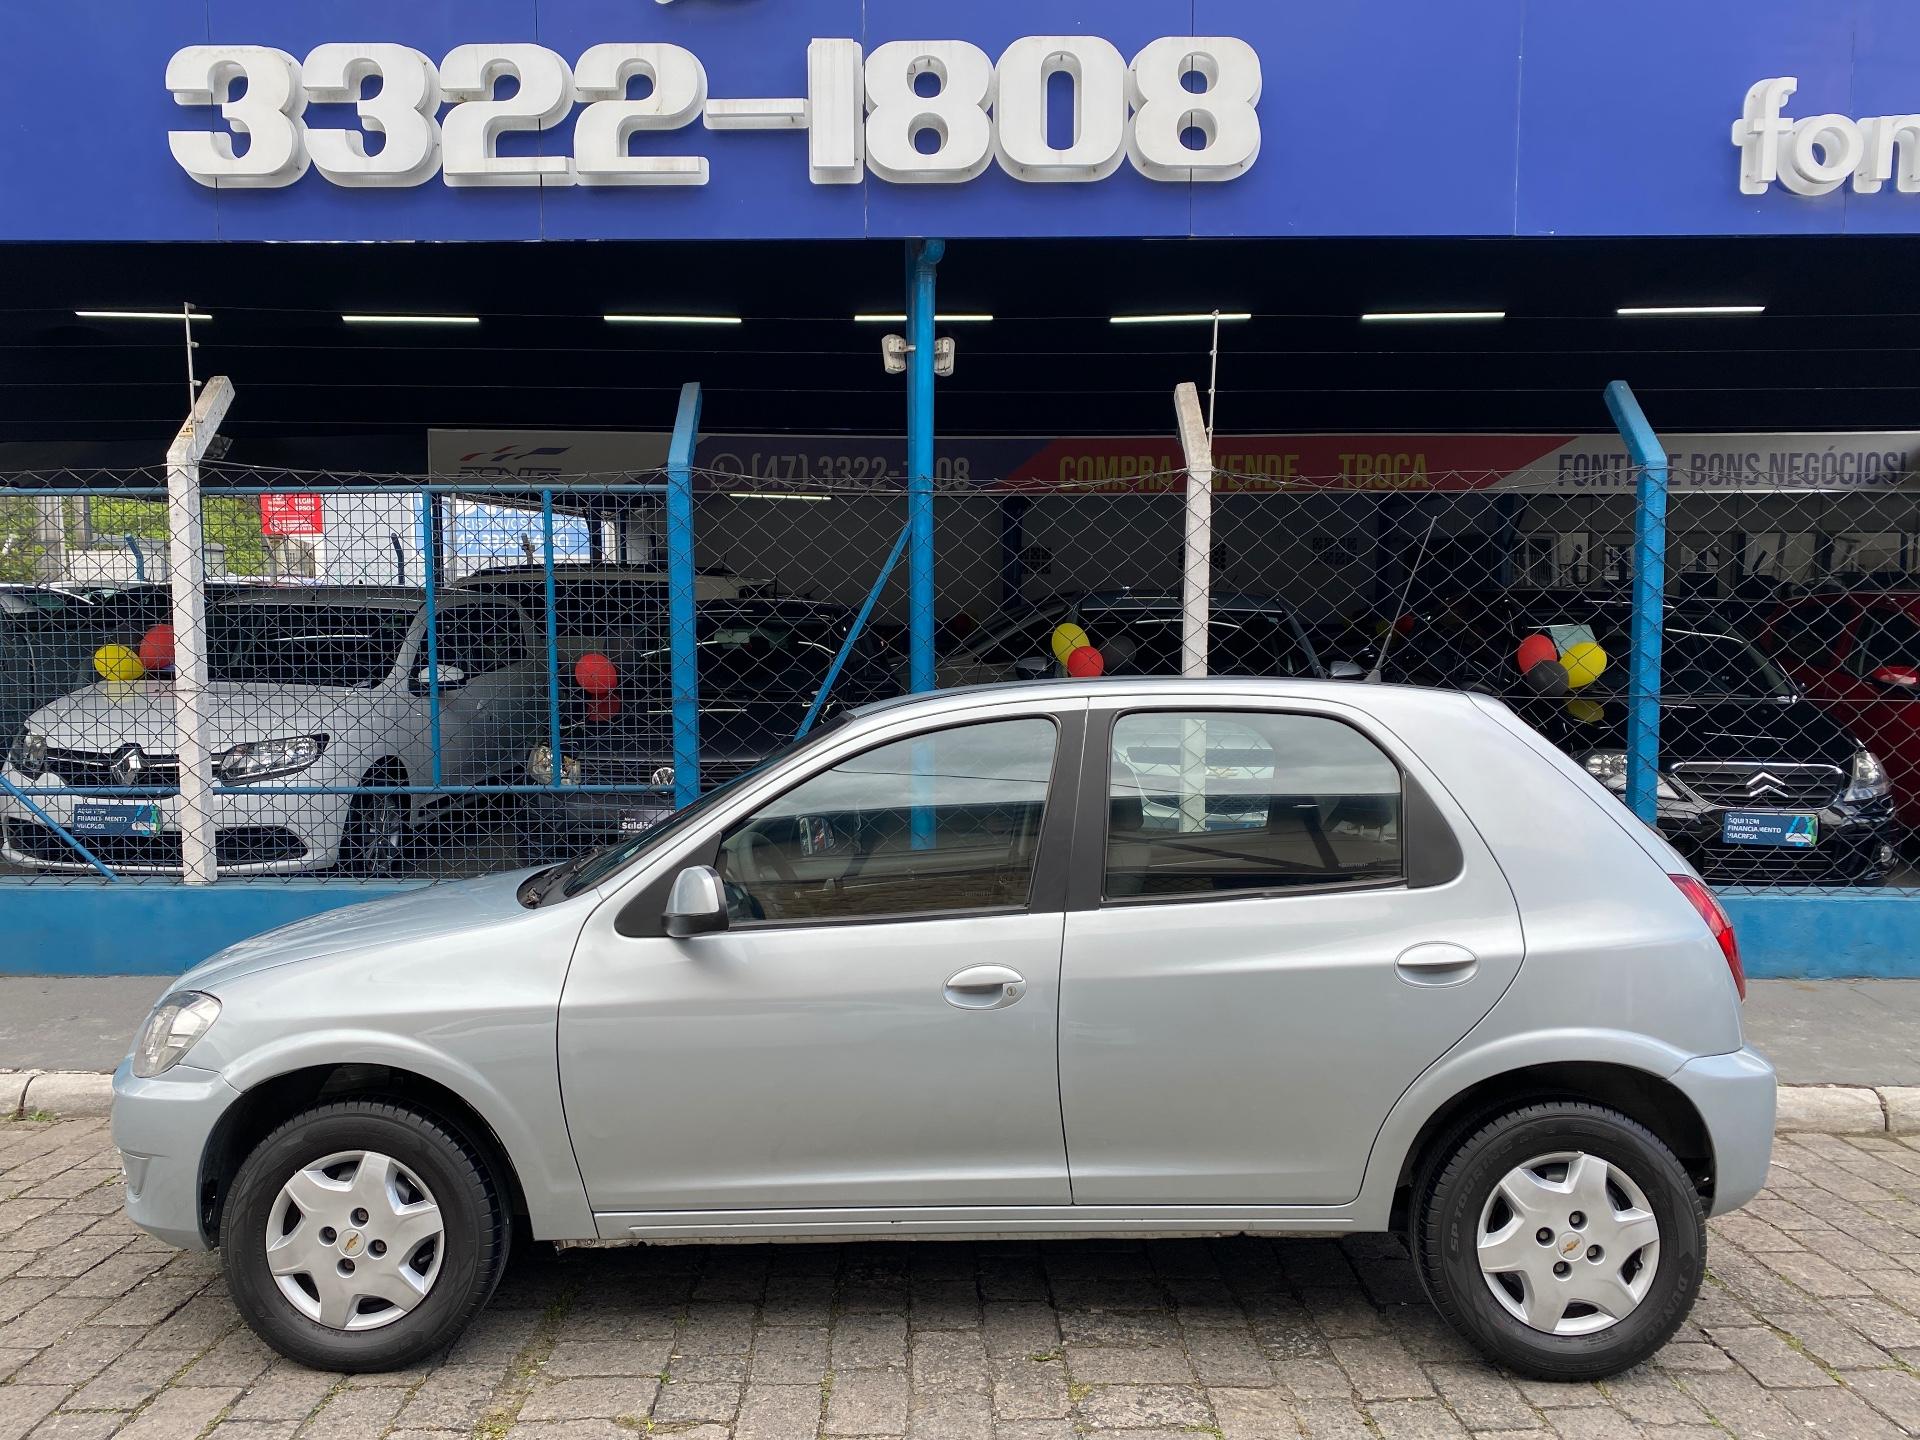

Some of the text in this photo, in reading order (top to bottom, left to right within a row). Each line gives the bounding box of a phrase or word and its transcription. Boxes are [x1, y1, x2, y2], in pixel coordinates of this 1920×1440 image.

[165, 35, 1261, 190] 3322-1808
[750, 453, 970, 491] (47) 3322-08
[1059, 453, 1429, 491] COMPRA VENDE TROCA
[1690, 452, 1761, 487] BONS
[1769, 446, 1908, 486] NEGÓCIOS!
[77, 815, 127, 823] FINANCIMENTO
